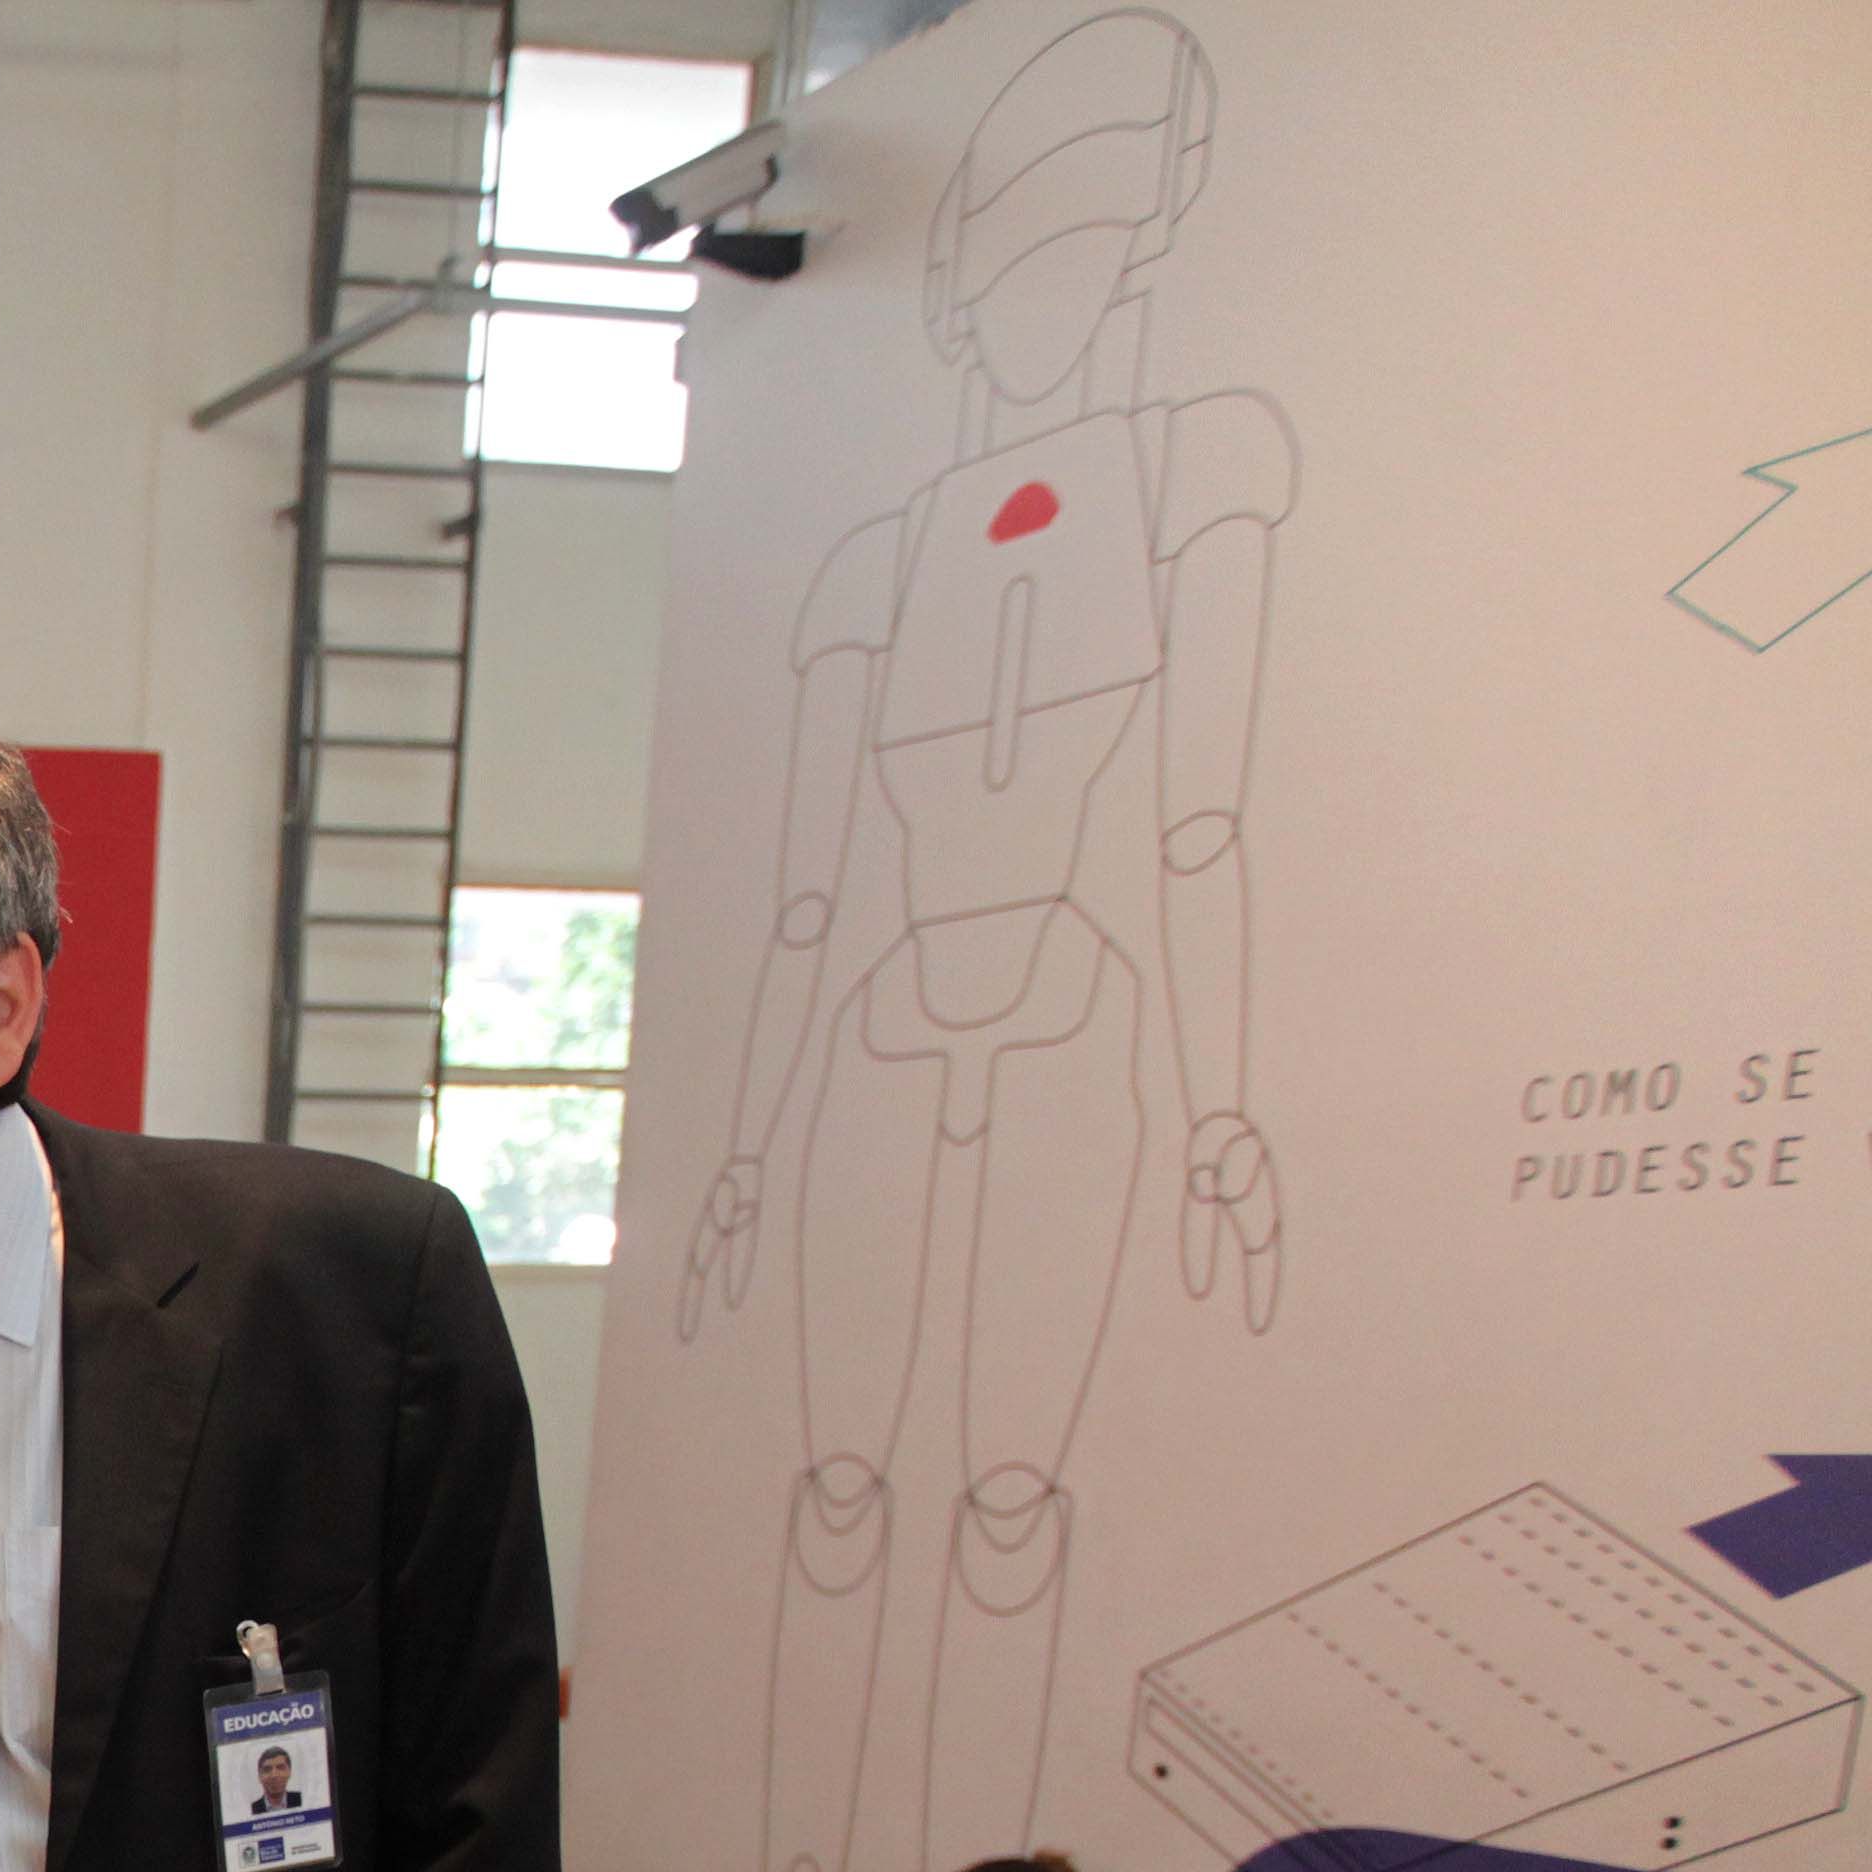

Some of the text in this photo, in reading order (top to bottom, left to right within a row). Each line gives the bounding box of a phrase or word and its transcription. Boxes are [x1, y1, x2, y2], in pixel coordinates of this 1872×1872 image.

[1521, 1046, 1823, 1124] COMO SE
[1509, 1133, 1807, 1203] PUDESSE
[223, 1702, 315, 1733] EDUCAÇÃO
